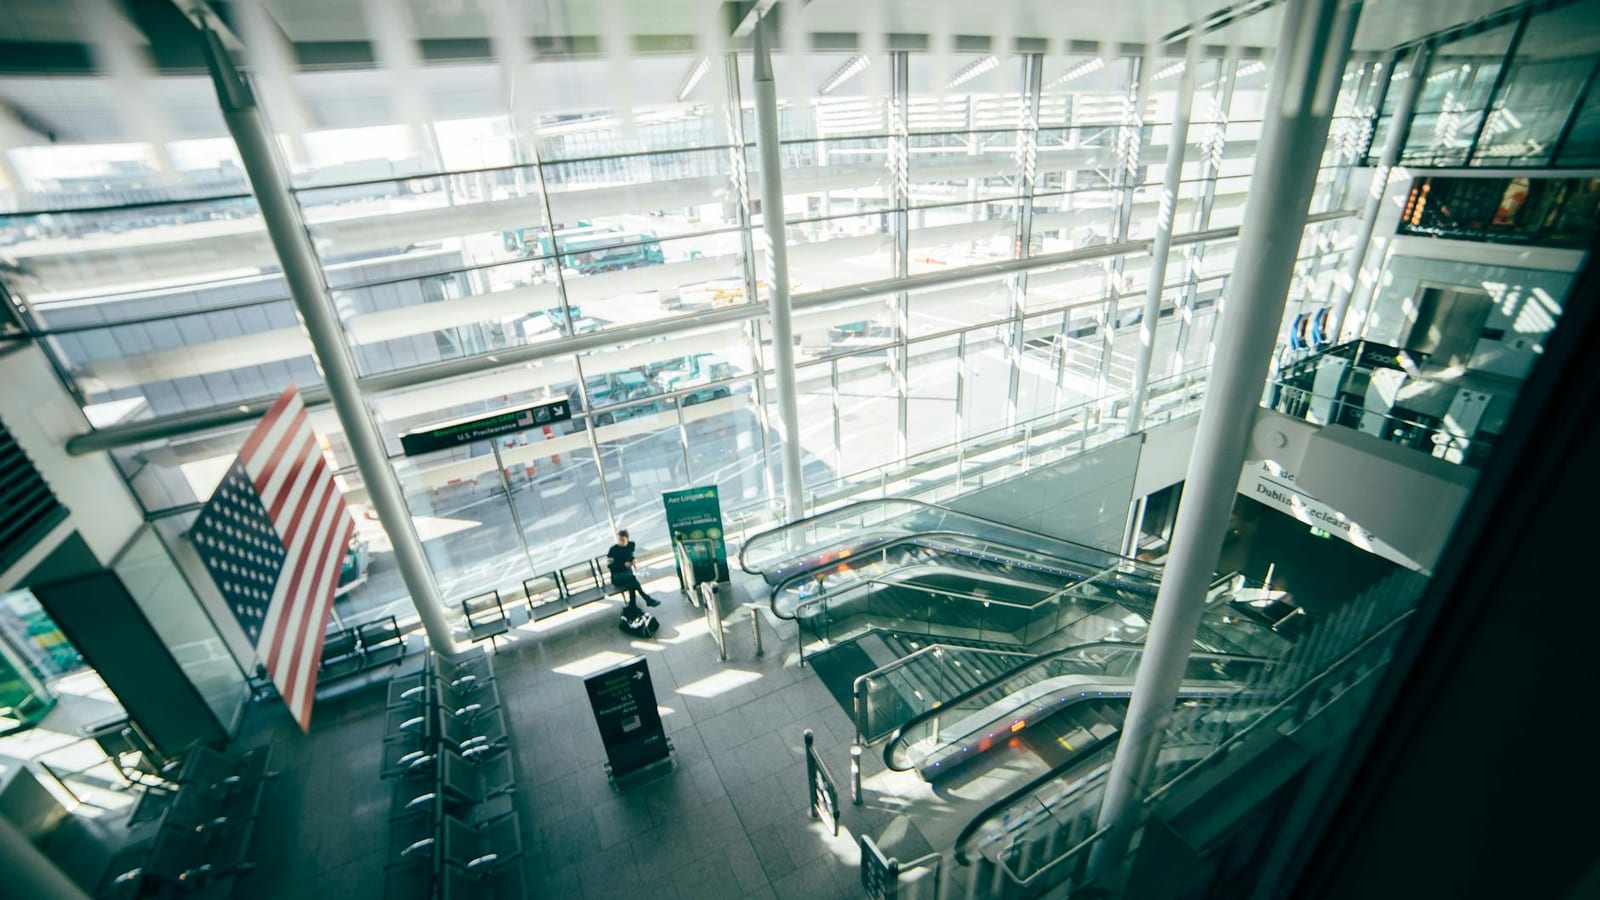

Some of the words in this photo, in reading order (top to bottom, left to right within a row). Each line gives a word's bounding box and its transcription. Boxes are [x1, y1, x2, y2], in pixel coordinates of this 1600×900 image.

[457, 432, 473, 441] U.S.
[472, 423, 517, 438] Preclearance
[681, 493, 705, 502] Lingus
[1256, 483, 1293, 507] Dublin
[1299, 501, 1377, 542] eclearae
